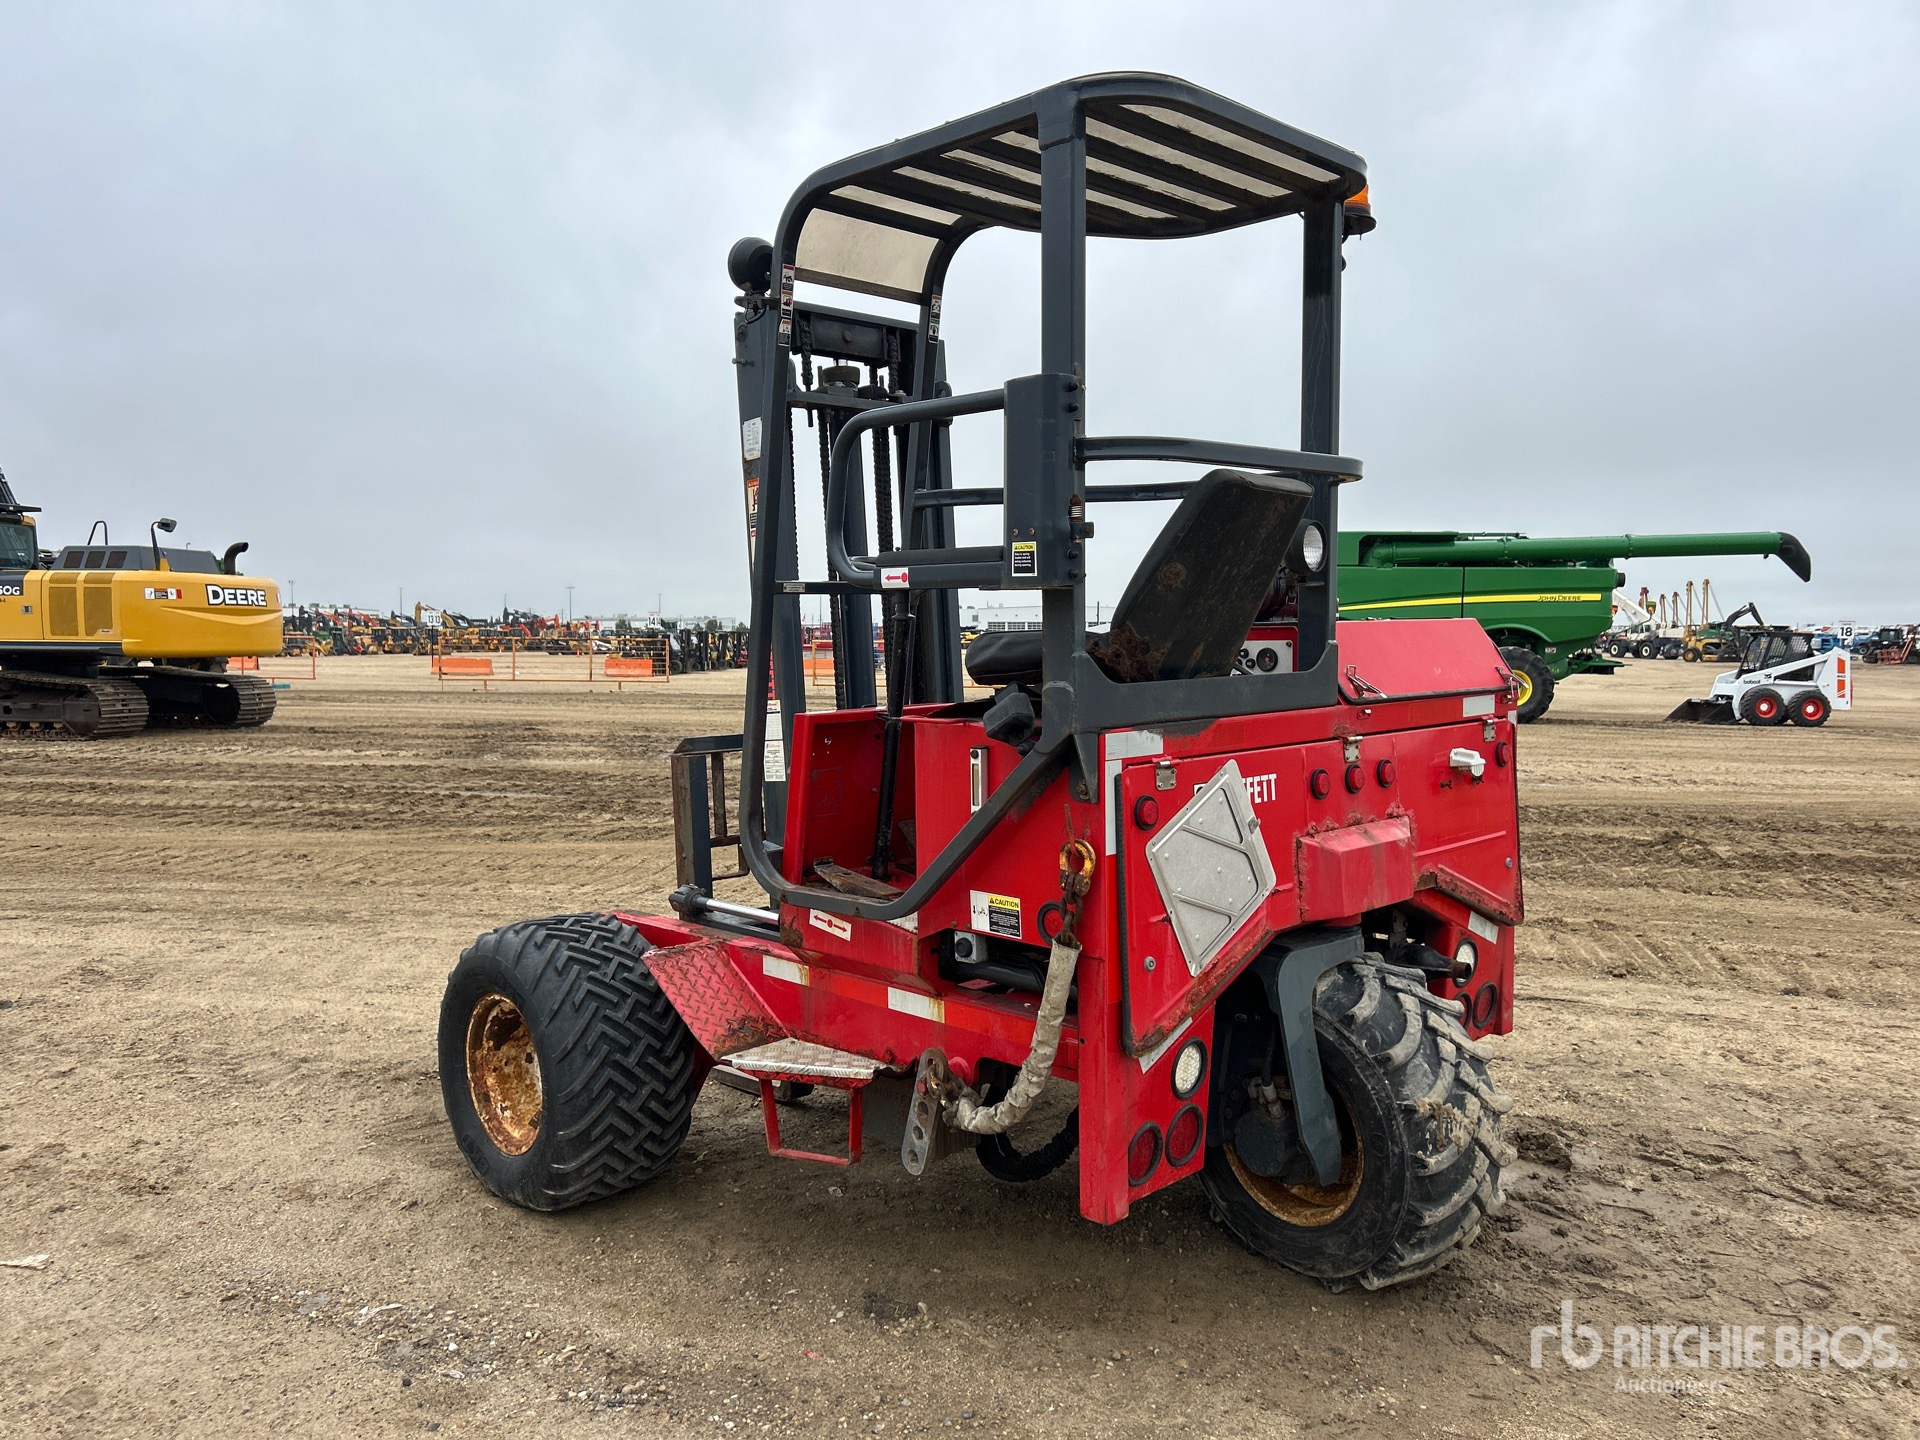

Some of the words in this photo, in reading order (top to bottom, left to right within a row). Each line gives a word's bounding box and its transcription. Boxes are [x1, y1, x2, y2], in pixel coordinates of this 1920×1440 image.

[206, 584, 267, 606] DEERE
[1840, 627, 1852, 636] 18
[994, 899, 1019, 908] CAUTION
